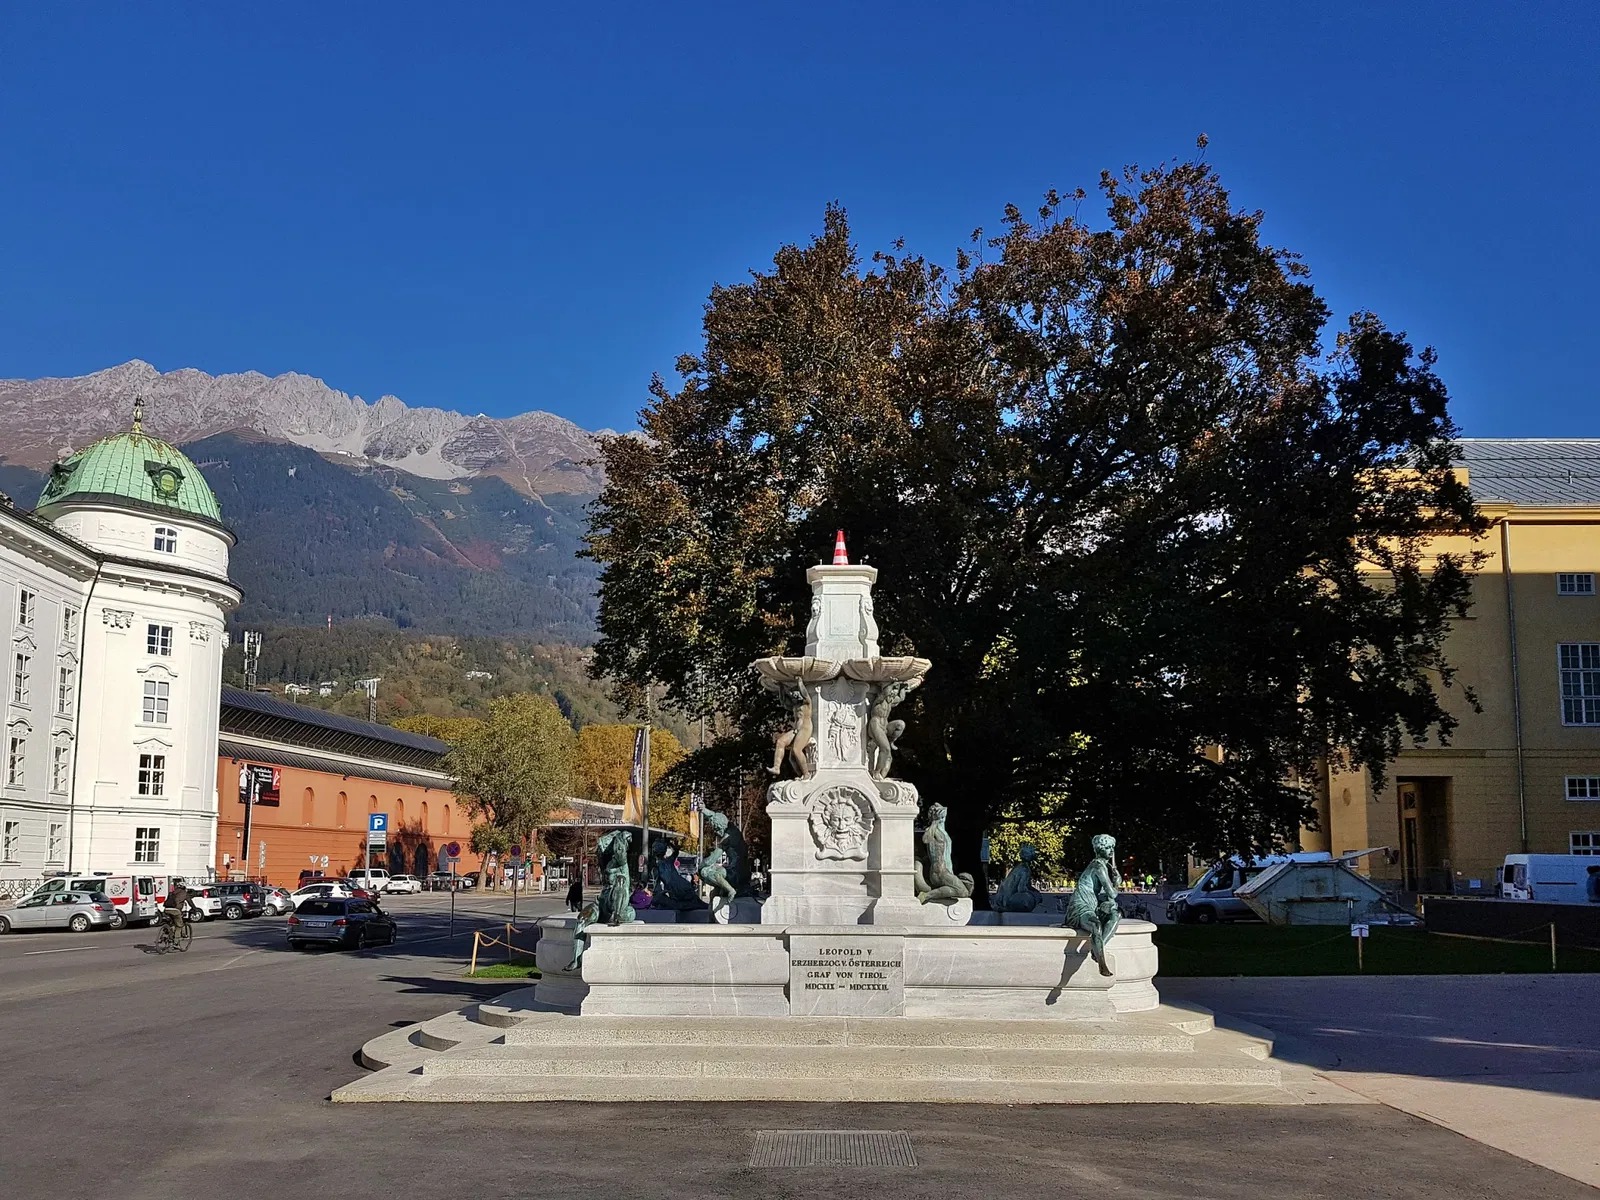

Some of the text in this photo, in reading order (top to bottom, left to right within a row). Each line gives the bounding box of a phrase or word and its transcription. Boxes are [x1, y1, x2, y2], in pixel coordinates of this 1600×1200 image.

[373, 818, 384, 829] P
[819, 948, 862, 956] LEOPOLD
[791, 959, 841, 967] ERZHERZOG
[848, 957, 901, 968] ÖSTERREICH
[807, 971, 831, 979] GRAF
[836, 971, 853, 979] VON
